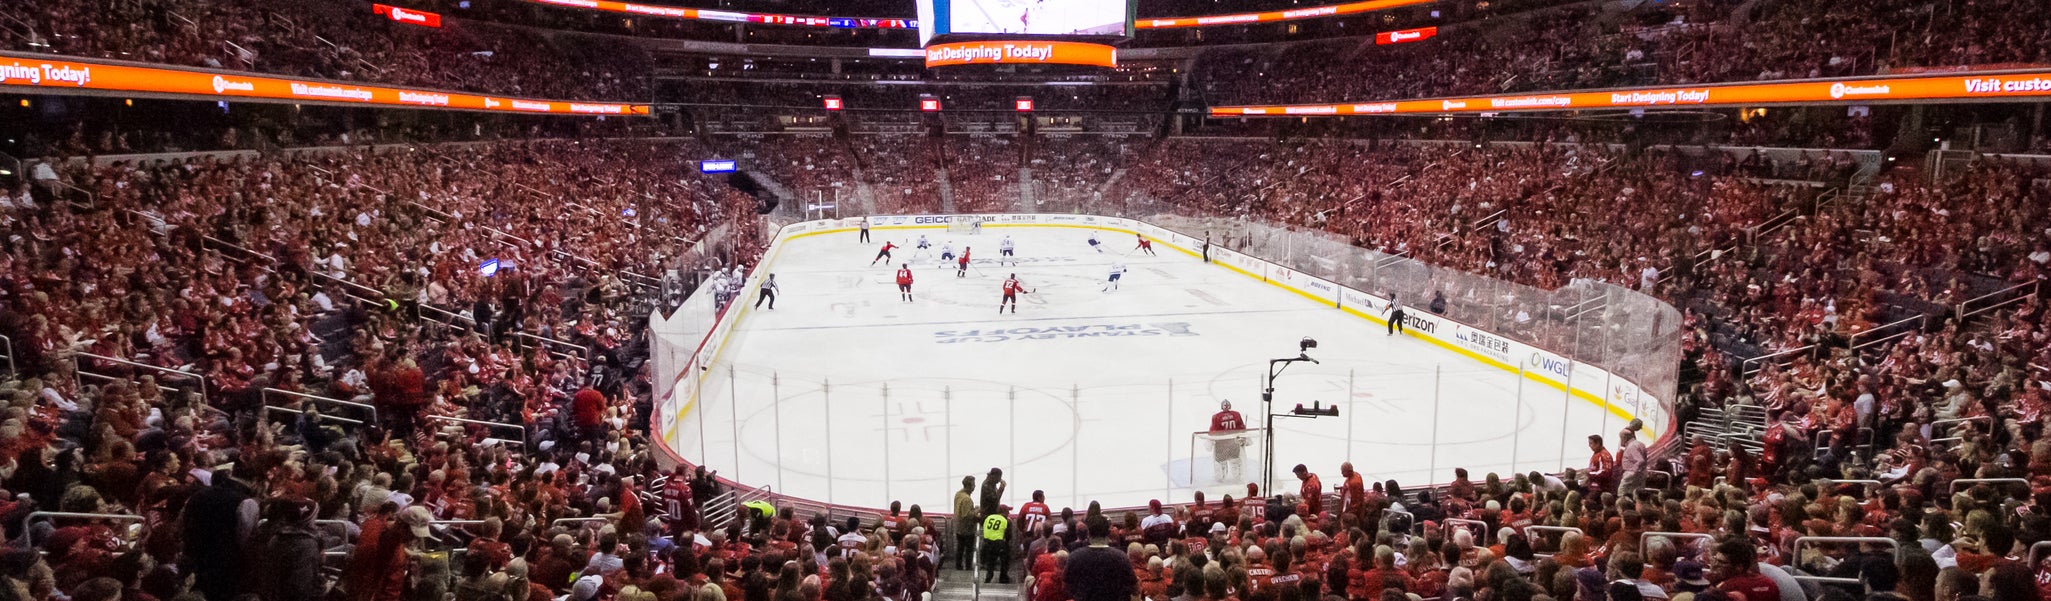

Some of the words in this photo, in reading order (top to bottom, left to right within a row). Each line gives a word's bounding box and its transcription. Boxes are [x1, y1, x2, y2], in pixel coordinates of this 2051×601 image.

[927, 48, 943, 62] Start
[944, 45, 1002, 62] Designing
[1004, 44, 1053, 60] Today!
[41, 63, 90, 86] Today!
[1964, 79, 2001, 93] Visit
[2003, 77, 2051, 91] custo
[1611, 93, 1632, 103] Start
[1632, 92, 1676, 104] Designing
[1677, 90, 1710, 103] Today!
[914, 216, 952, 224] GEICO
[1311, 281, 1331, 292] BOEING
[1402, 312, 1435, 334] erizon
[1542, 357, 1568, 377] WGL
[590, 373, 604, 387] 77
[986, 518, 1001, 531] 58
